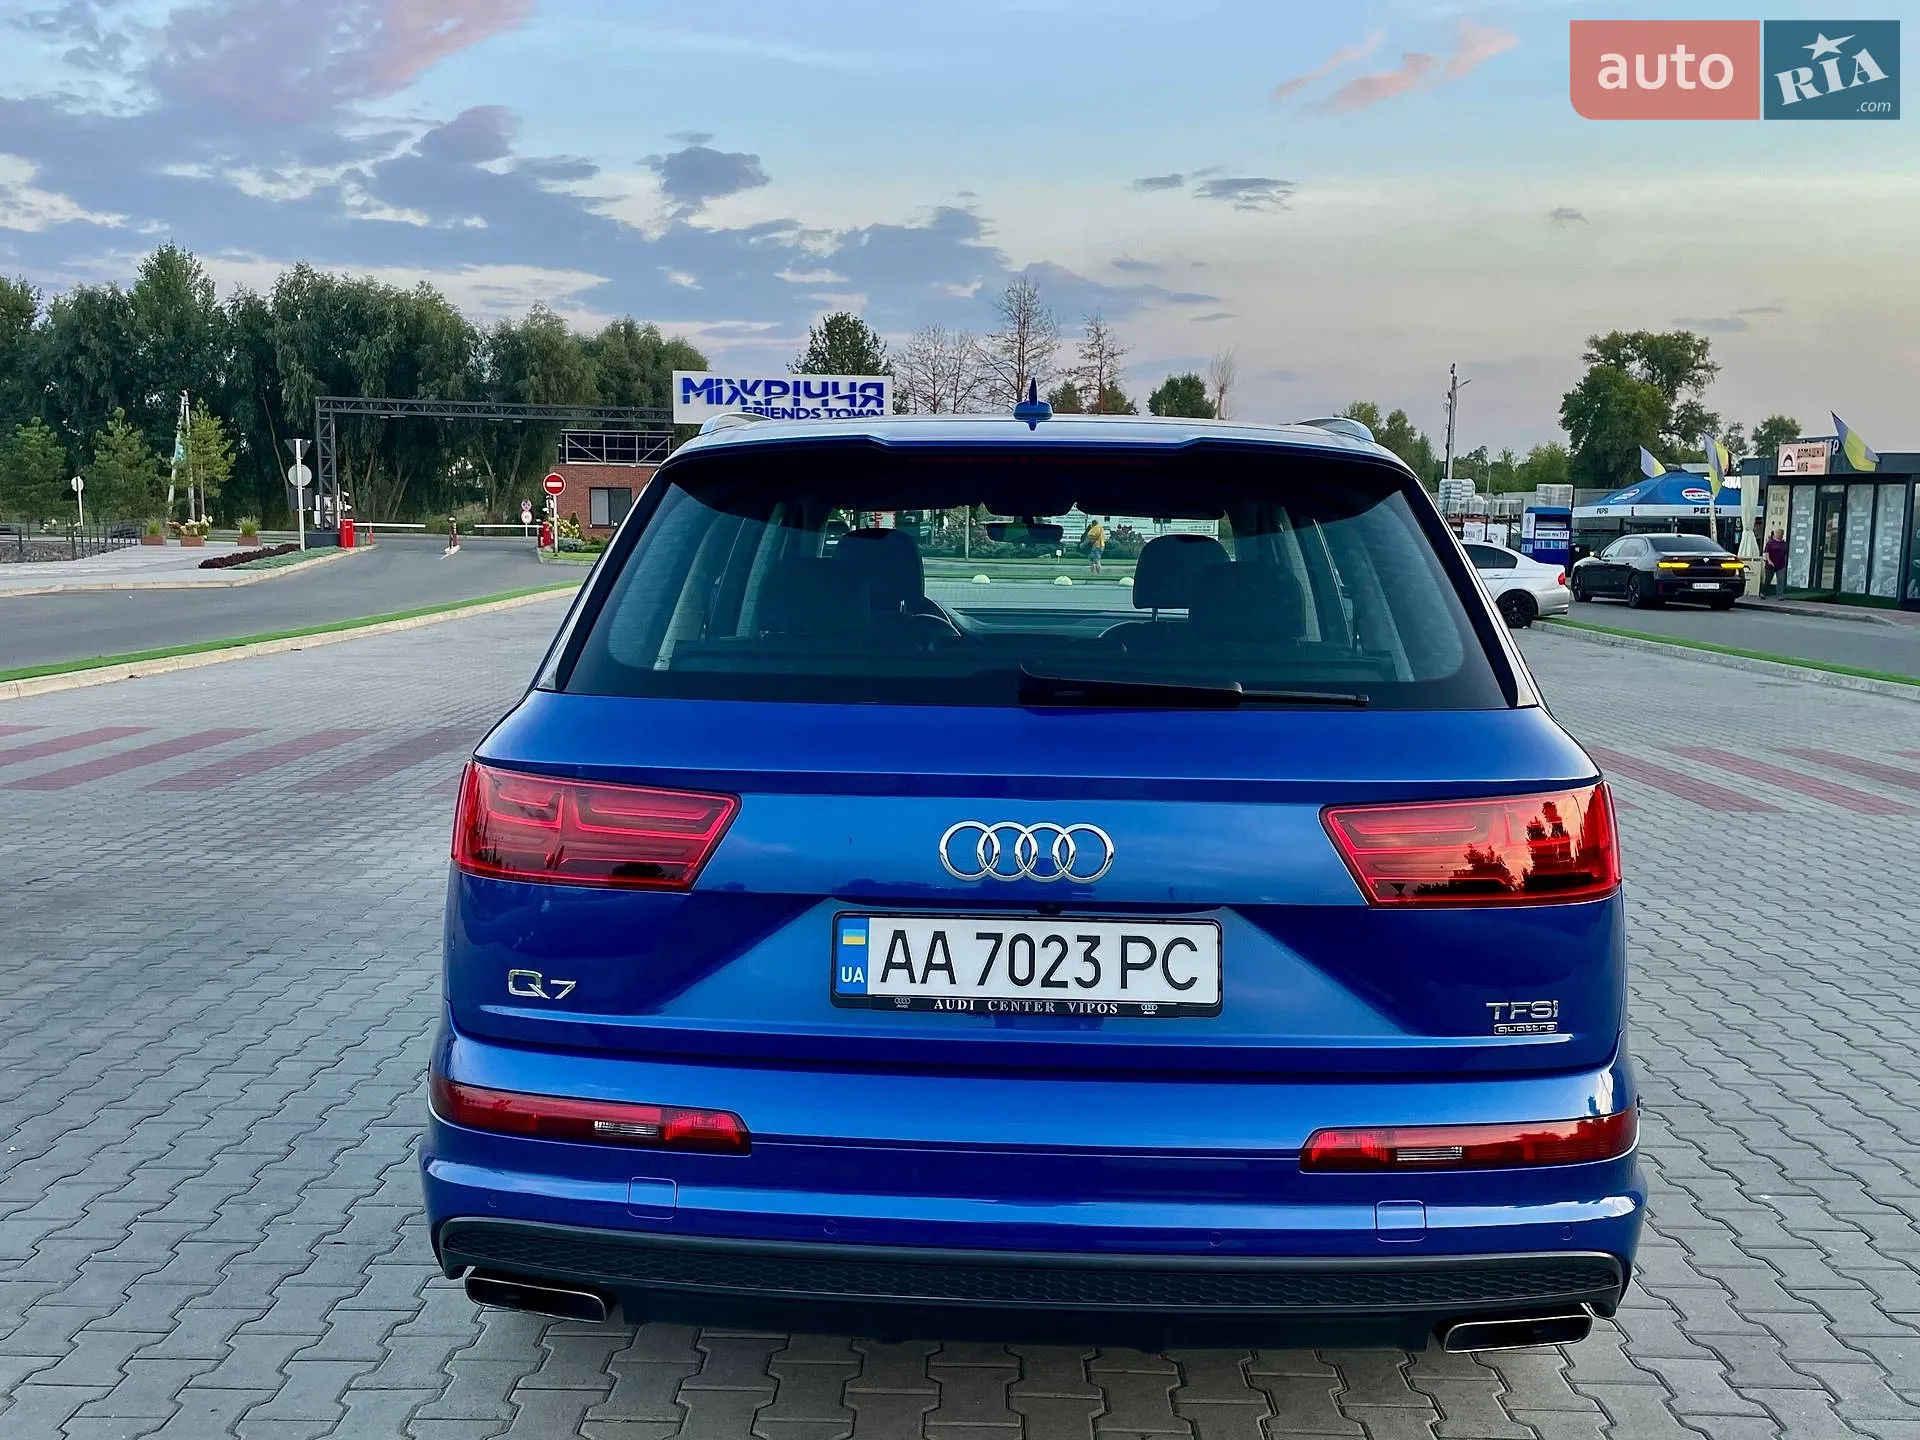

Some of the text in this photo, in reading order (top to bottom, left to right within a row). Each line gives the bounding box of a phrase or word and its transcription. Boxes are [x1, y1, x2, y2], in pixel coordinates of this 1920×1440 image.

[682, 377, 884, 408] МІЖРІЧЧЯ
[742, 406, 884, 420] FRIENDS TOWN
[880, 929, 1199, 991] AA 7023 PC
[841, 966, 865, 983] UA
[508, 969, 577, 999] Q7
[934, 999, 1119, 1015] AUDI CENTER VIPOS
[1497, 1023, 1556, 1034] quattro
